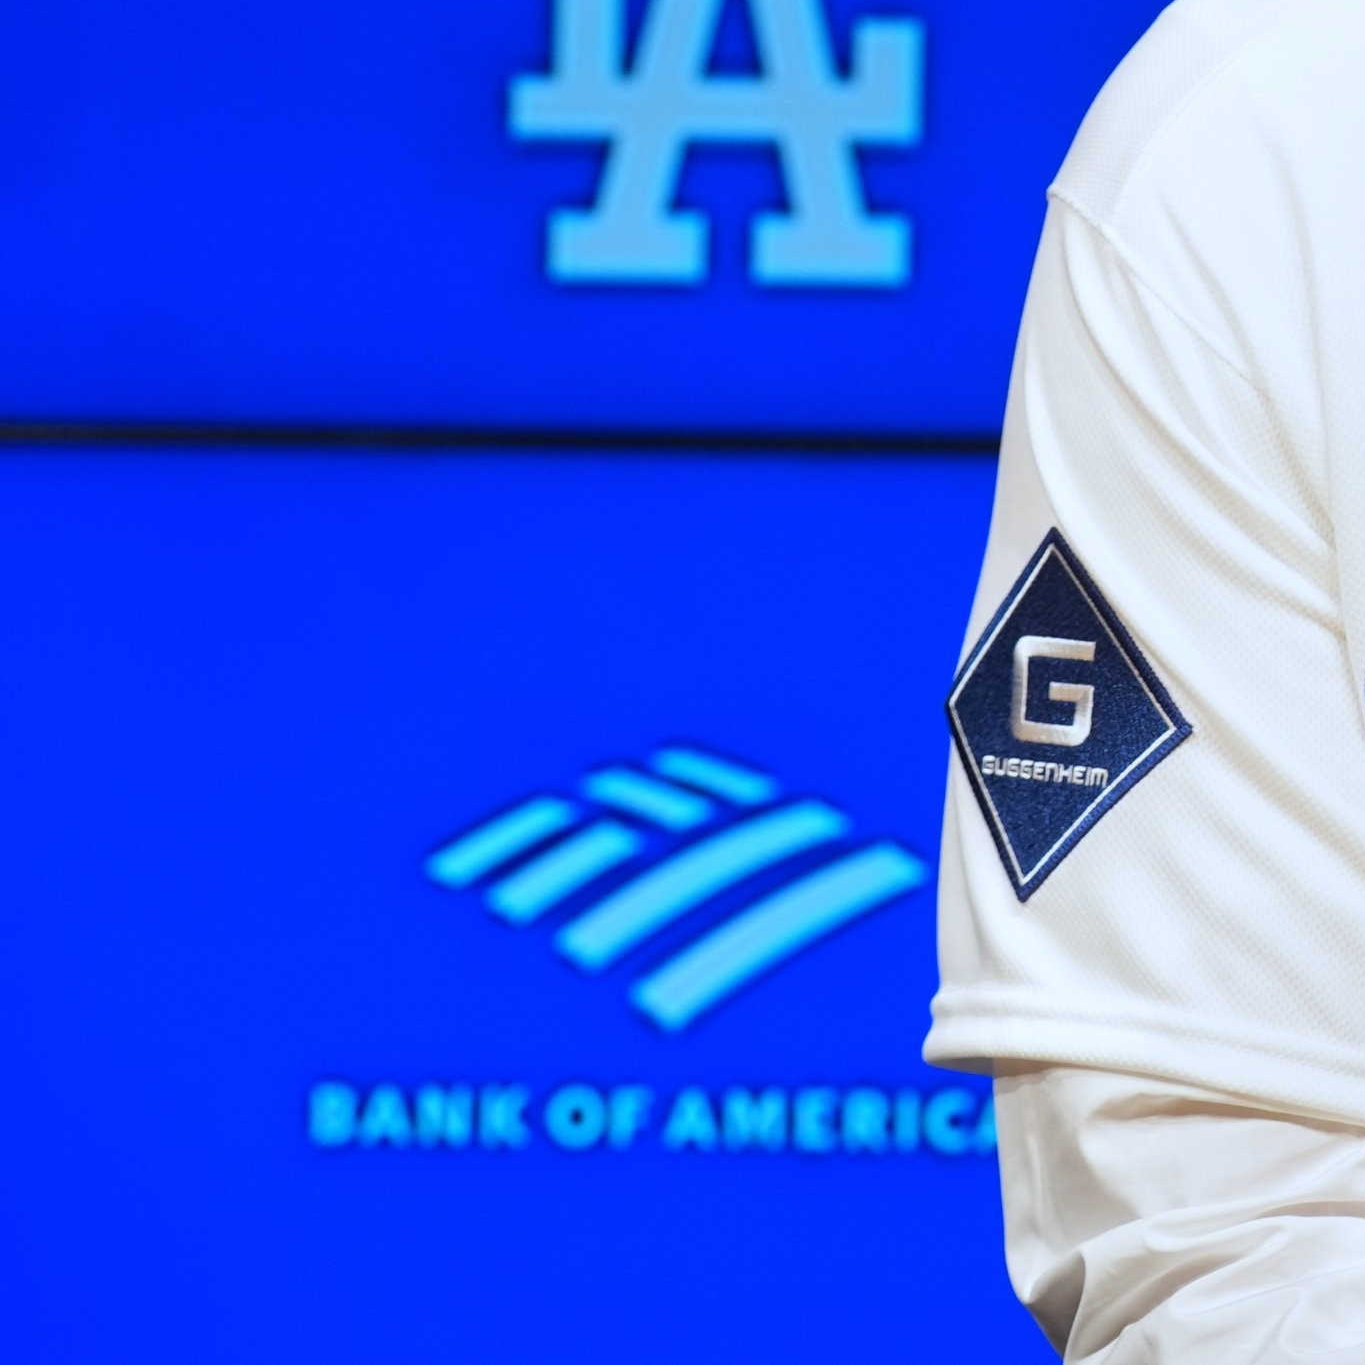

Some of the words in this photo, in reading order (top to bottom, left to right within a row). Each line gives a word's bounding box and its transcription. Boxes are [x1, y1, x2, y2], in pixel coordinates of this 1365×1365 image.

[1012, 635, 1097, 747] G
[981, 754, 1110, 788] GUGGENHEIM
[308, 1081, 530, 1149] BANK
[544, 1084, 653, 1151] OF
